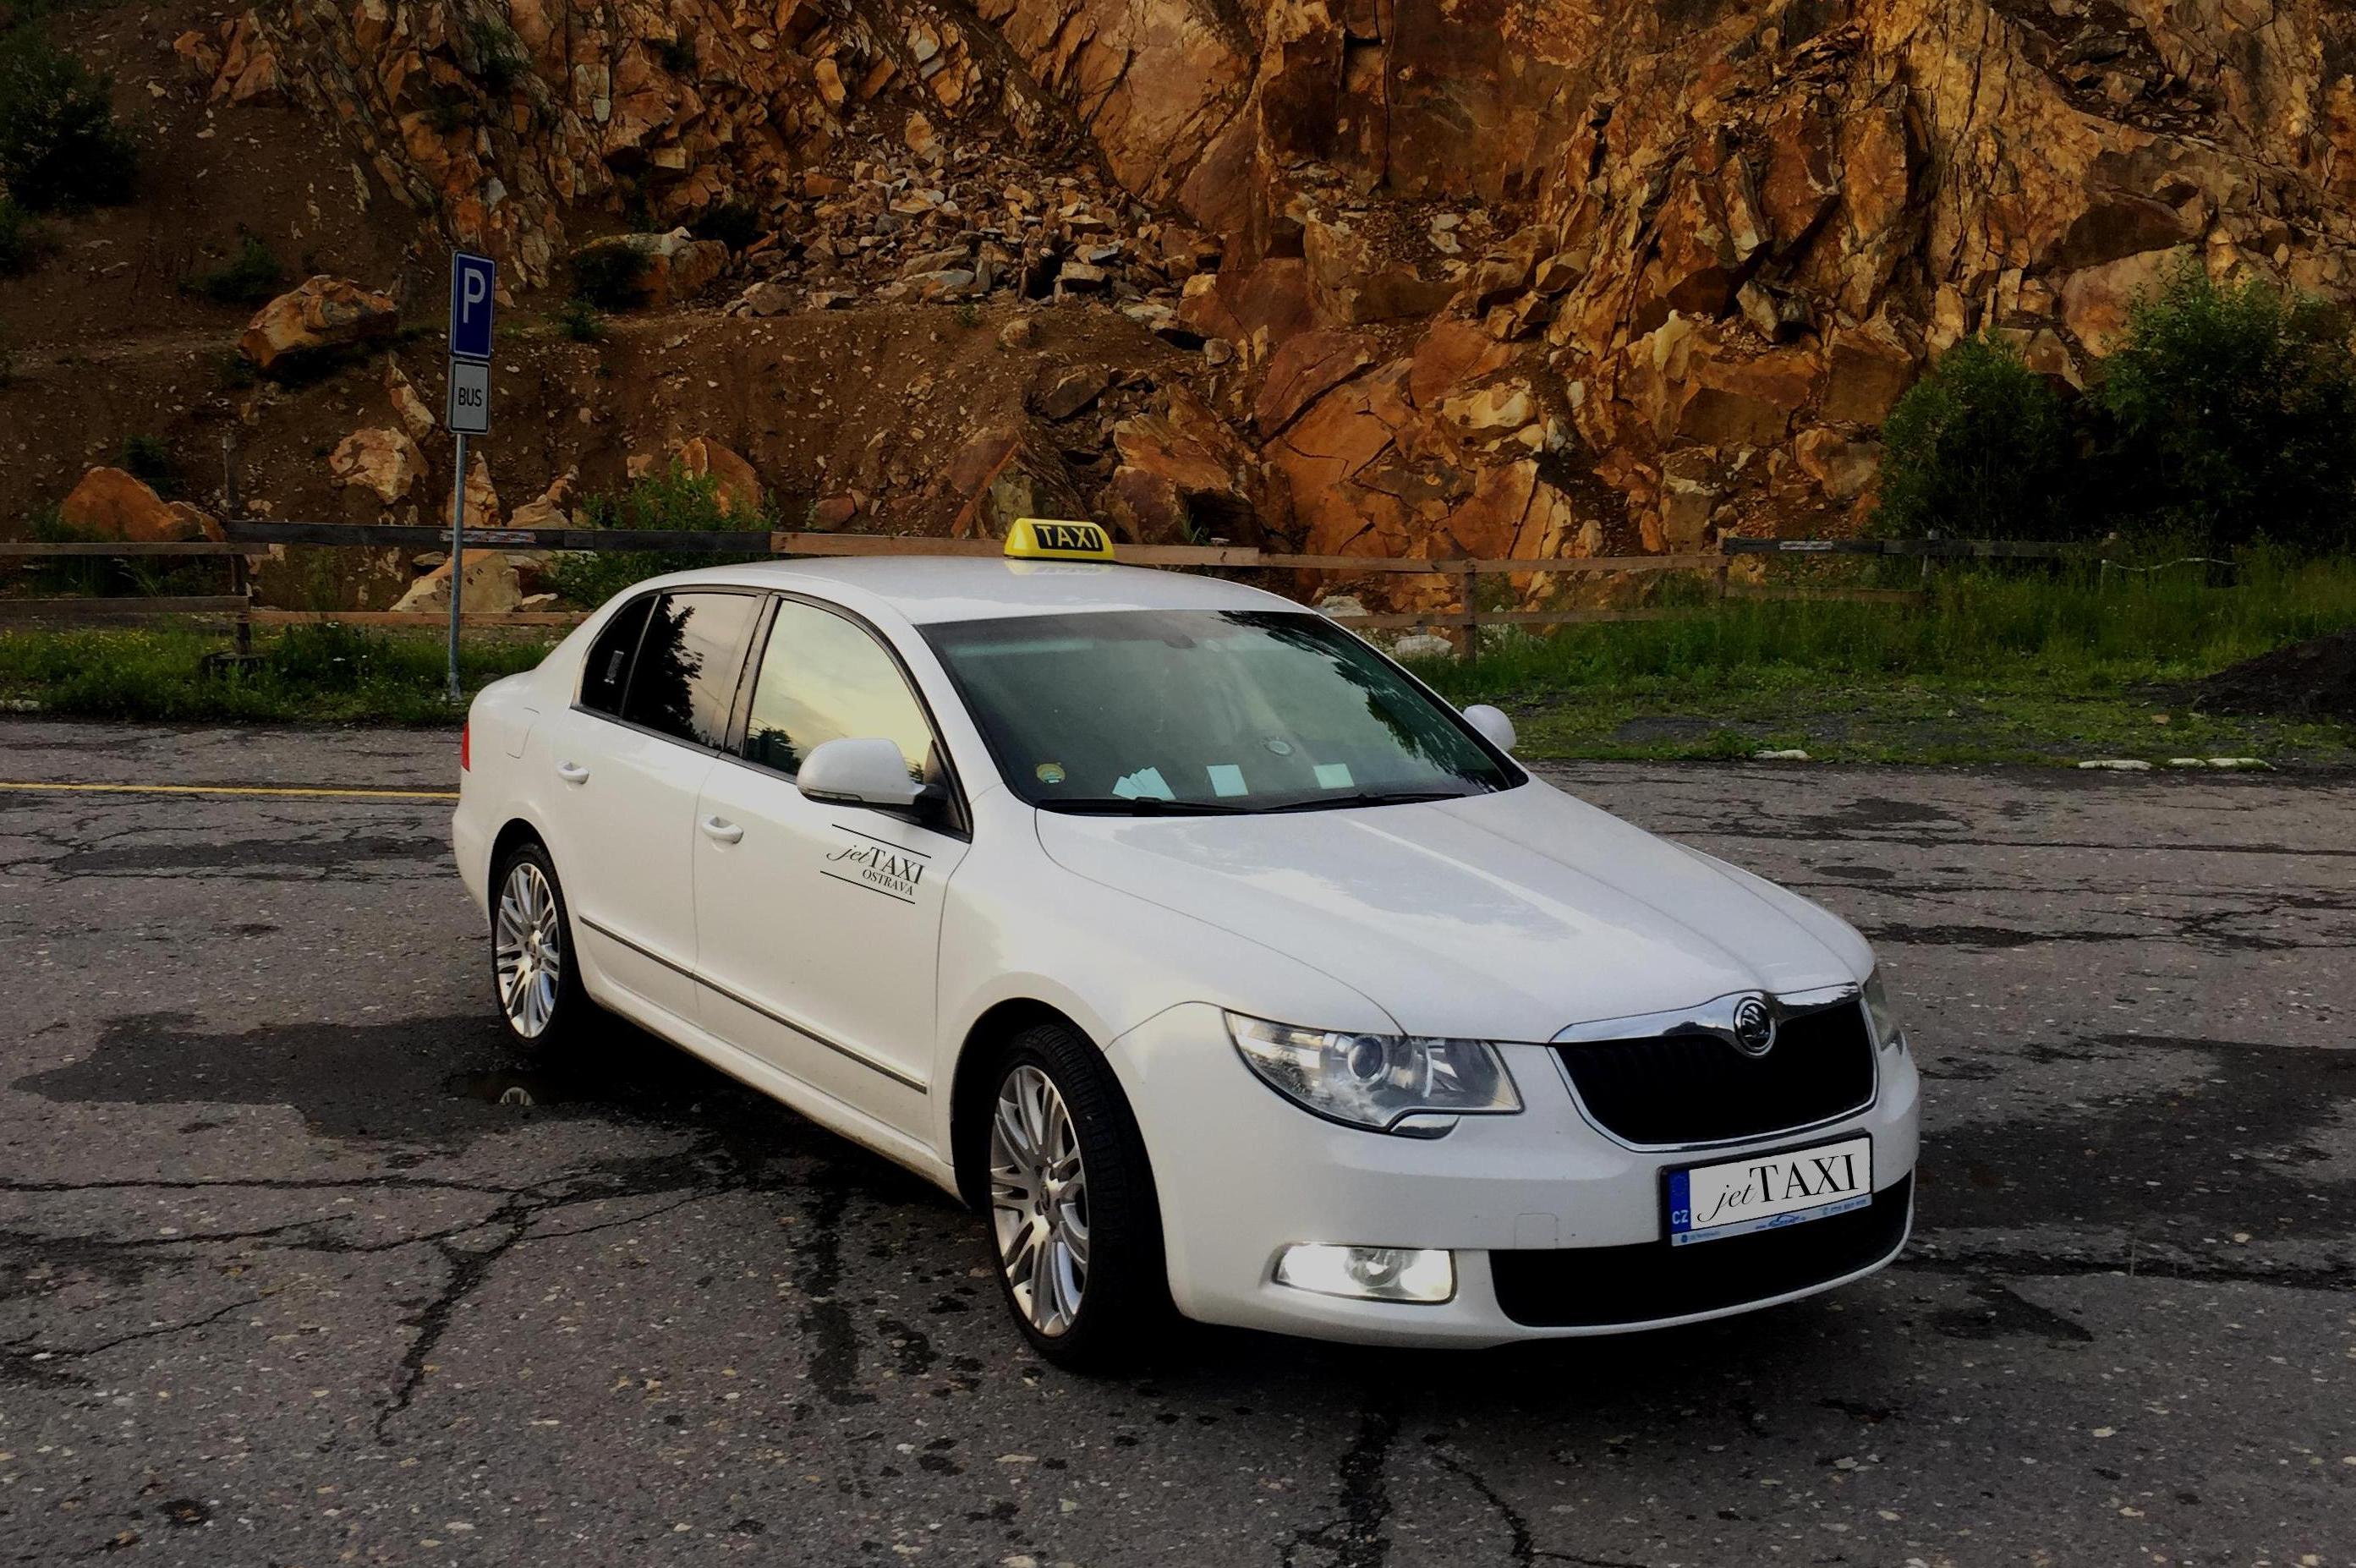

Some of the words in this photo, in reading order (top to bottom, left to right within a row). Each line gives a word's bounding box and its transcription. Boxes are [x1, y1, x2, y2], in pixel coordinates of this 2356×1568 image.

[463, 267, 485, 324] P
[458, 387, 482, 407] BUS
[1037, 525, 1099, 549] TAXI
[862, 869, 913, 896] OSTRAVA
[1672, 1209, 1689, 1225] CZ
